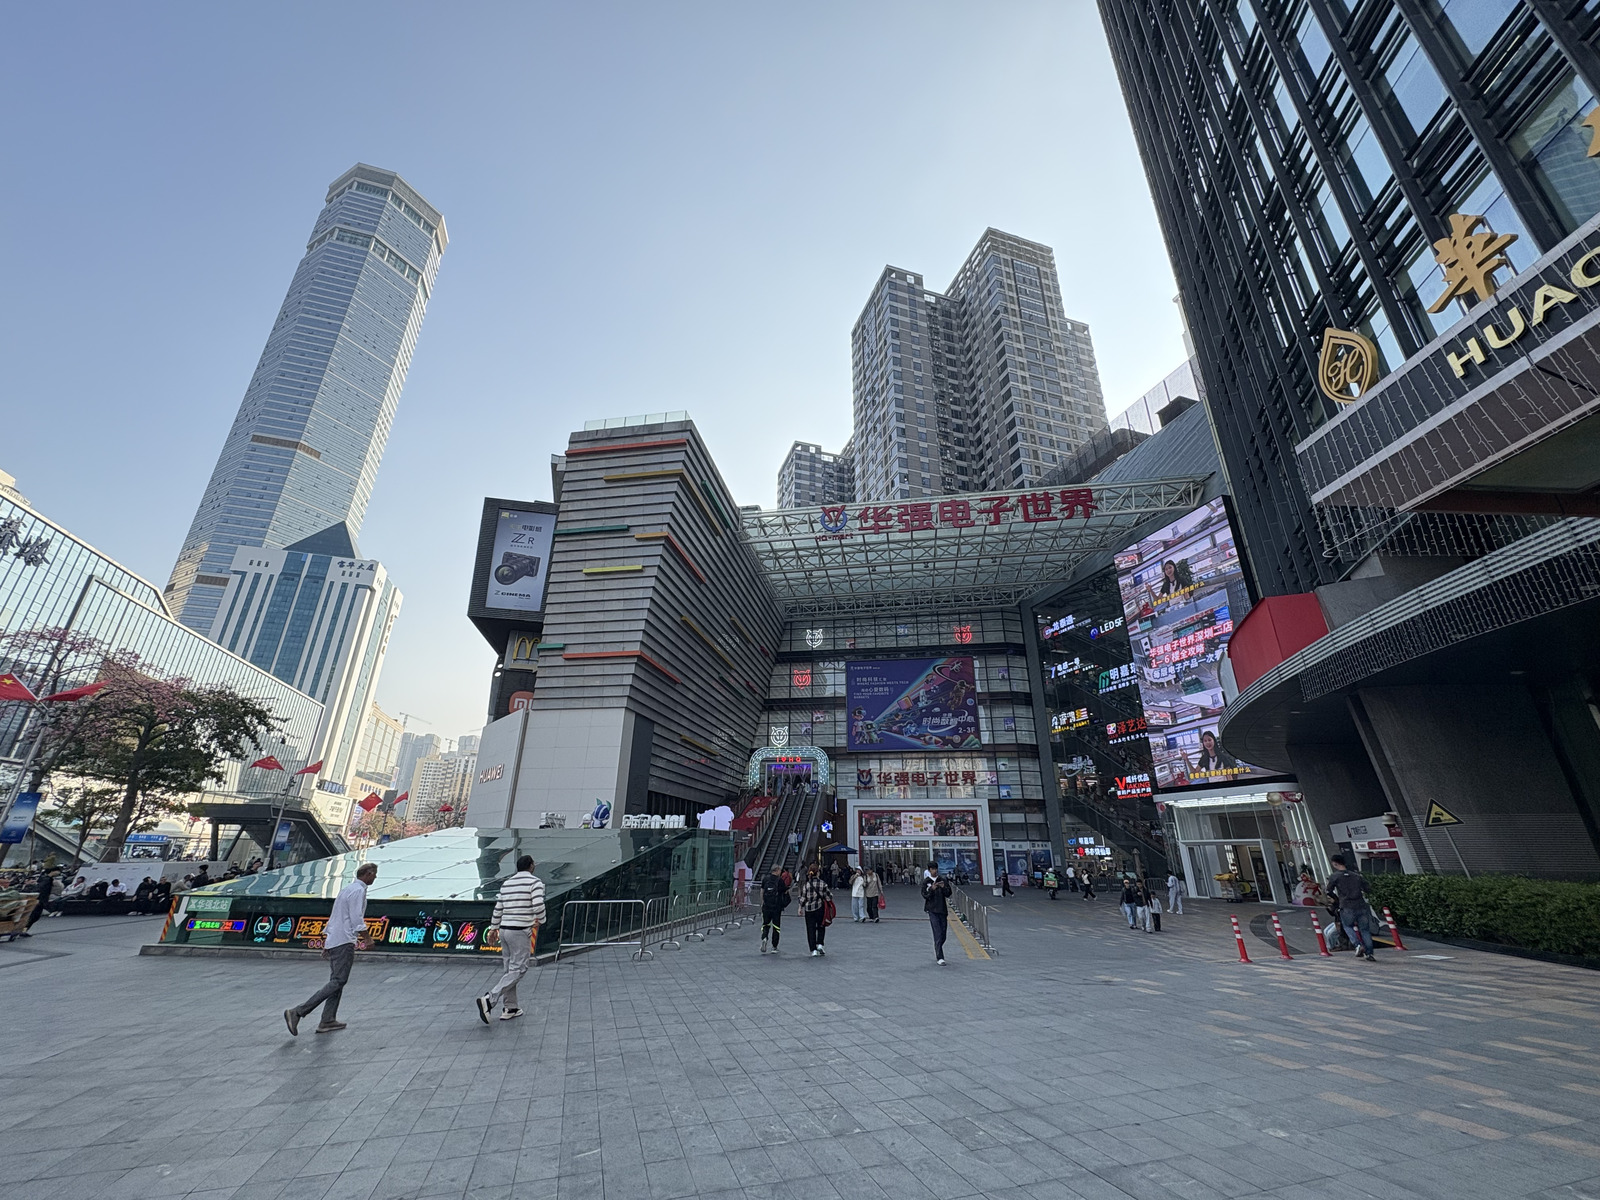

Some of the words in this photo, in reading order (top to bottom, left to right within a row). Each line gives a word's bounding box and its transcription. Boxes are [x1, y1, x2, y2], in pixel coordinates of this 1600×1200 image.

[858, 488, 1098, 534] 华强电子世界
[1149, 620, 1233, 658] 华强电子世界深圳二店
[479, 763, 505, 784] HUAWEI
[877, 770, 977, 786] 华强电子世界
[197, 899, 228, 910] 华强北站
